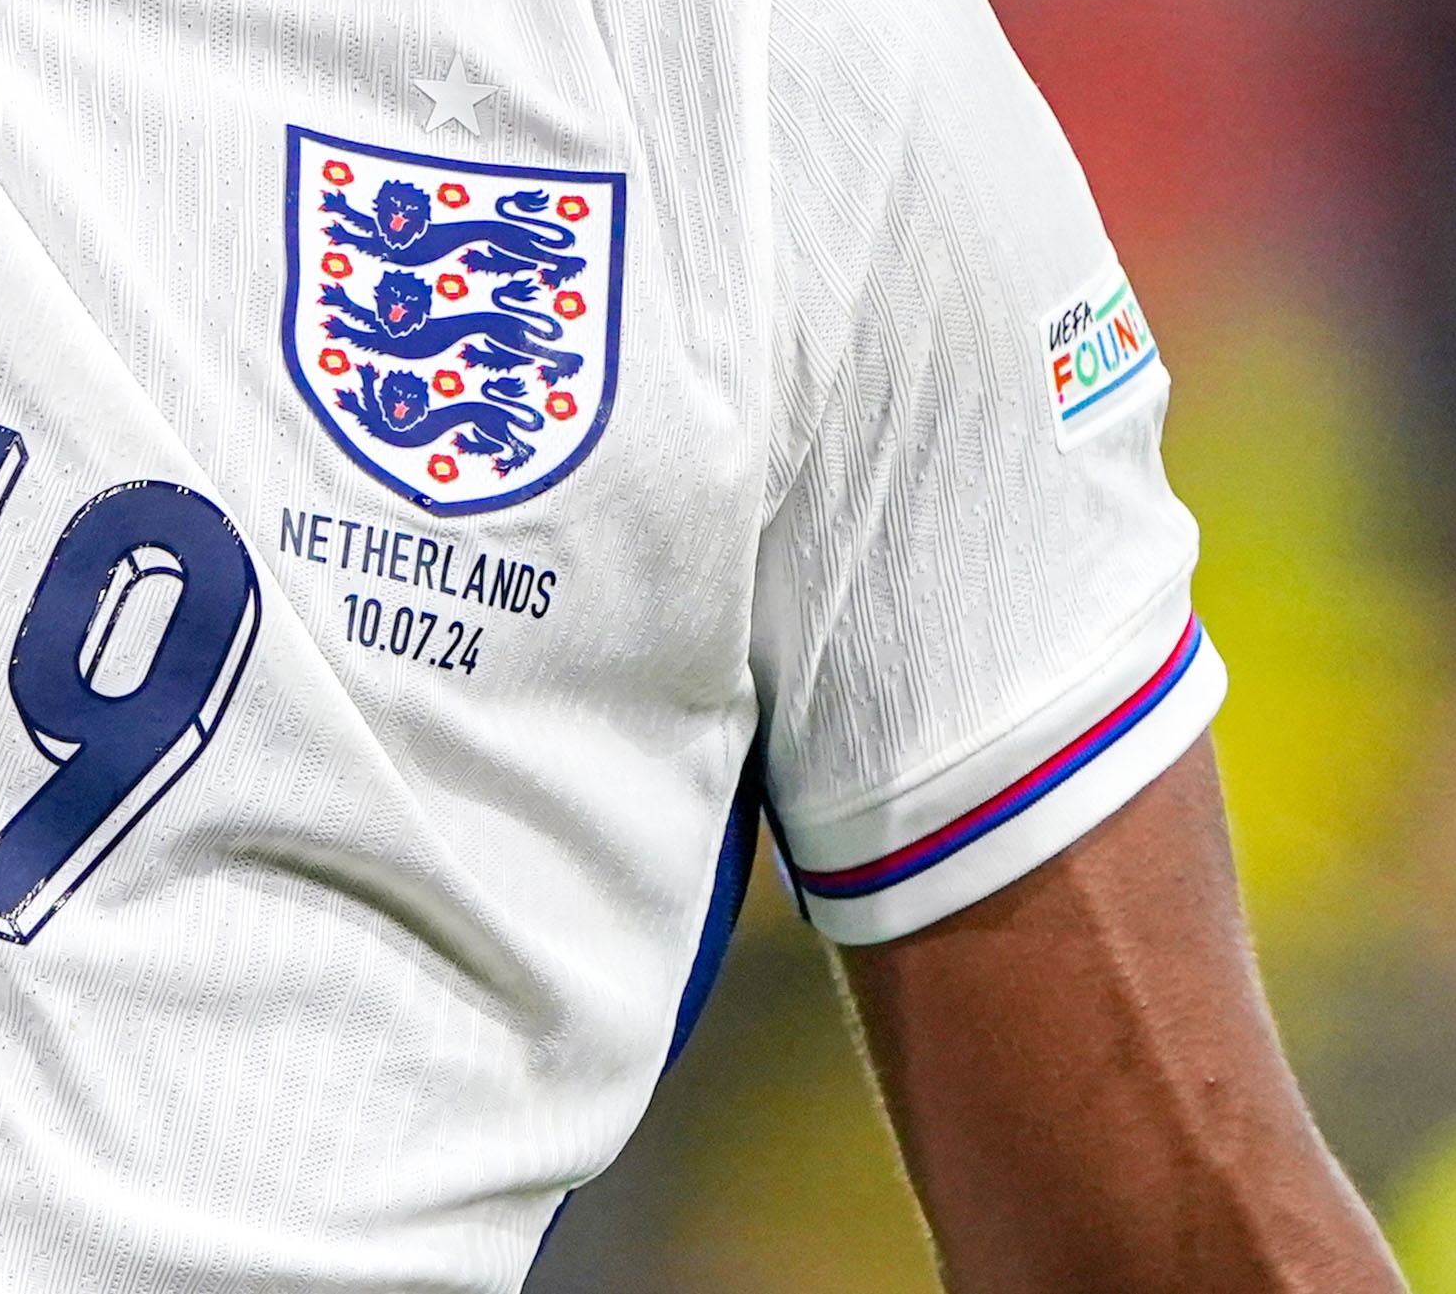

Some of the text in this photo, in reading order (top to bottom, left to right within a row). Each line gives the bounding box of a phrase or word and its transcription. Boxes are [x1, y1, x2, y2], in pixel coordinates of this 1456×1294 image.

[1050, 300, 1094, 351] UEFA
[280, 507, 557, 619] NETHERLANDS
[344, 594, 484, 675] 10.07.24
